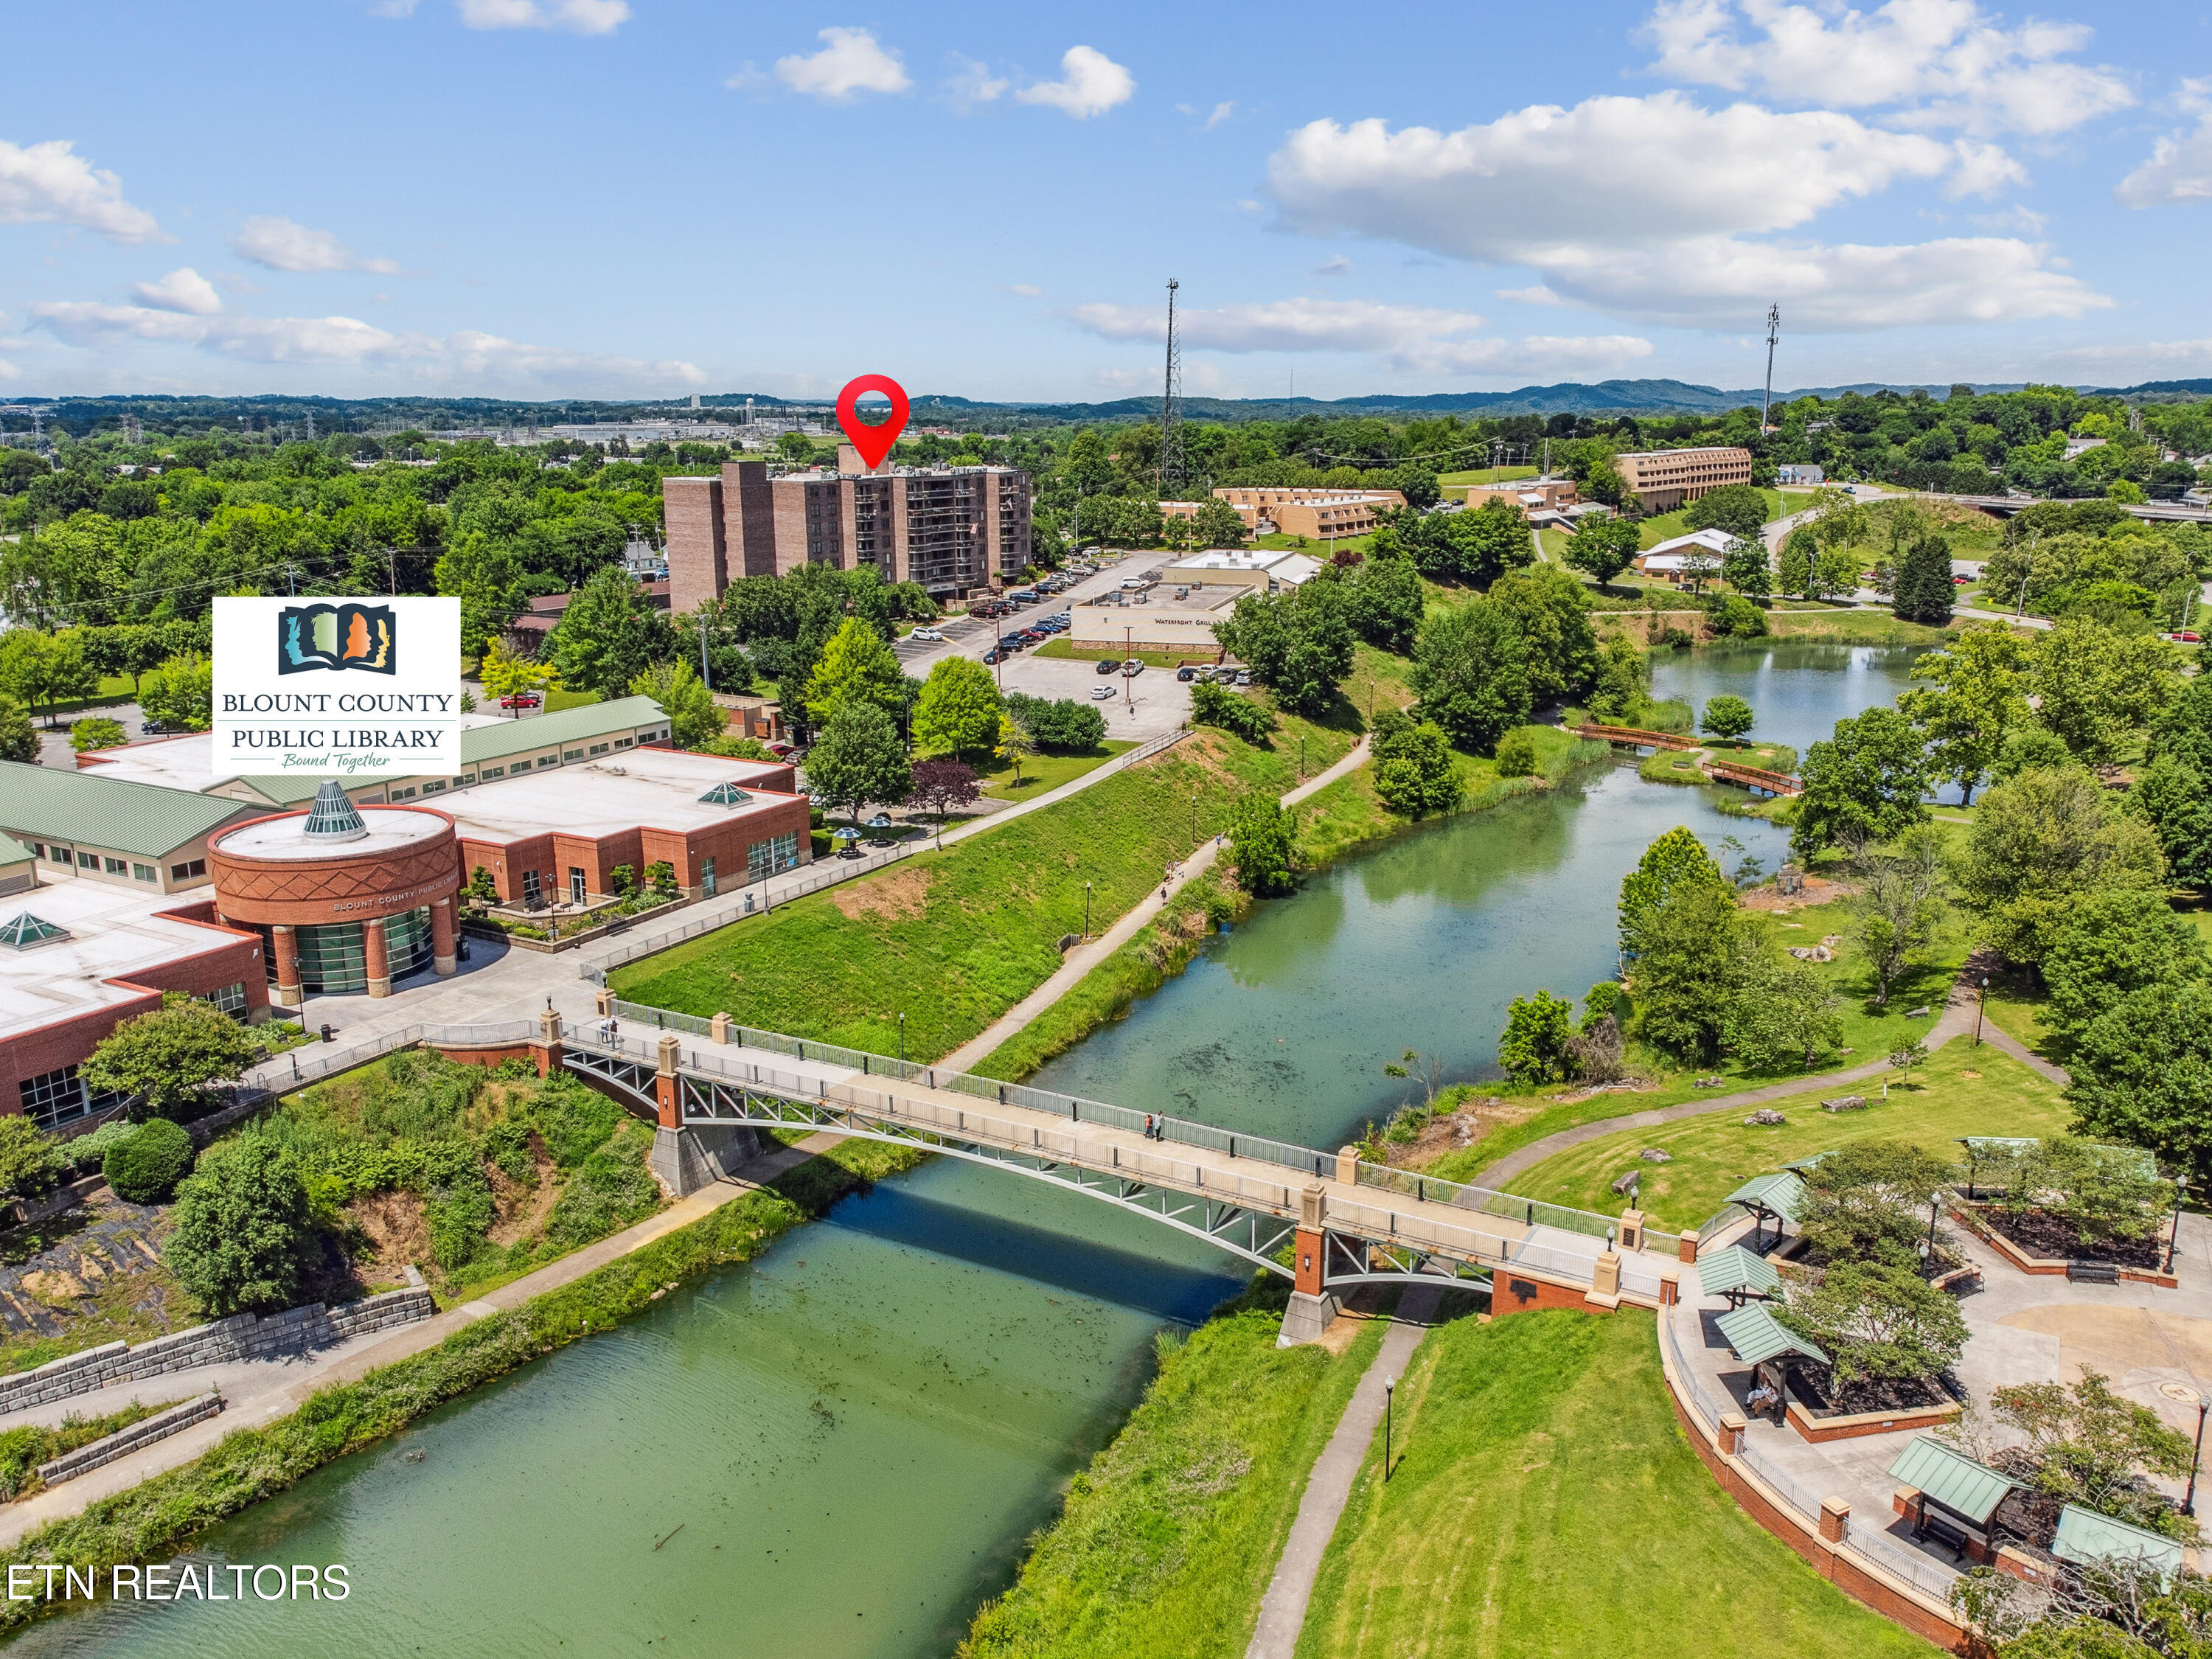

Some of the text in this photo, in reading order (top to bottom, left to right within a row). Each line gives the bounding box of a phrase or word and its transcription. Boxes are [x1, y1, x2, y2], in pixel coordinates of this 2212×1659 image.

[333, 899, 374, 911] BLOUNT
[378, 890, 415, 905] COUNTY
[418, 882, 442, 896] PUBLIC
